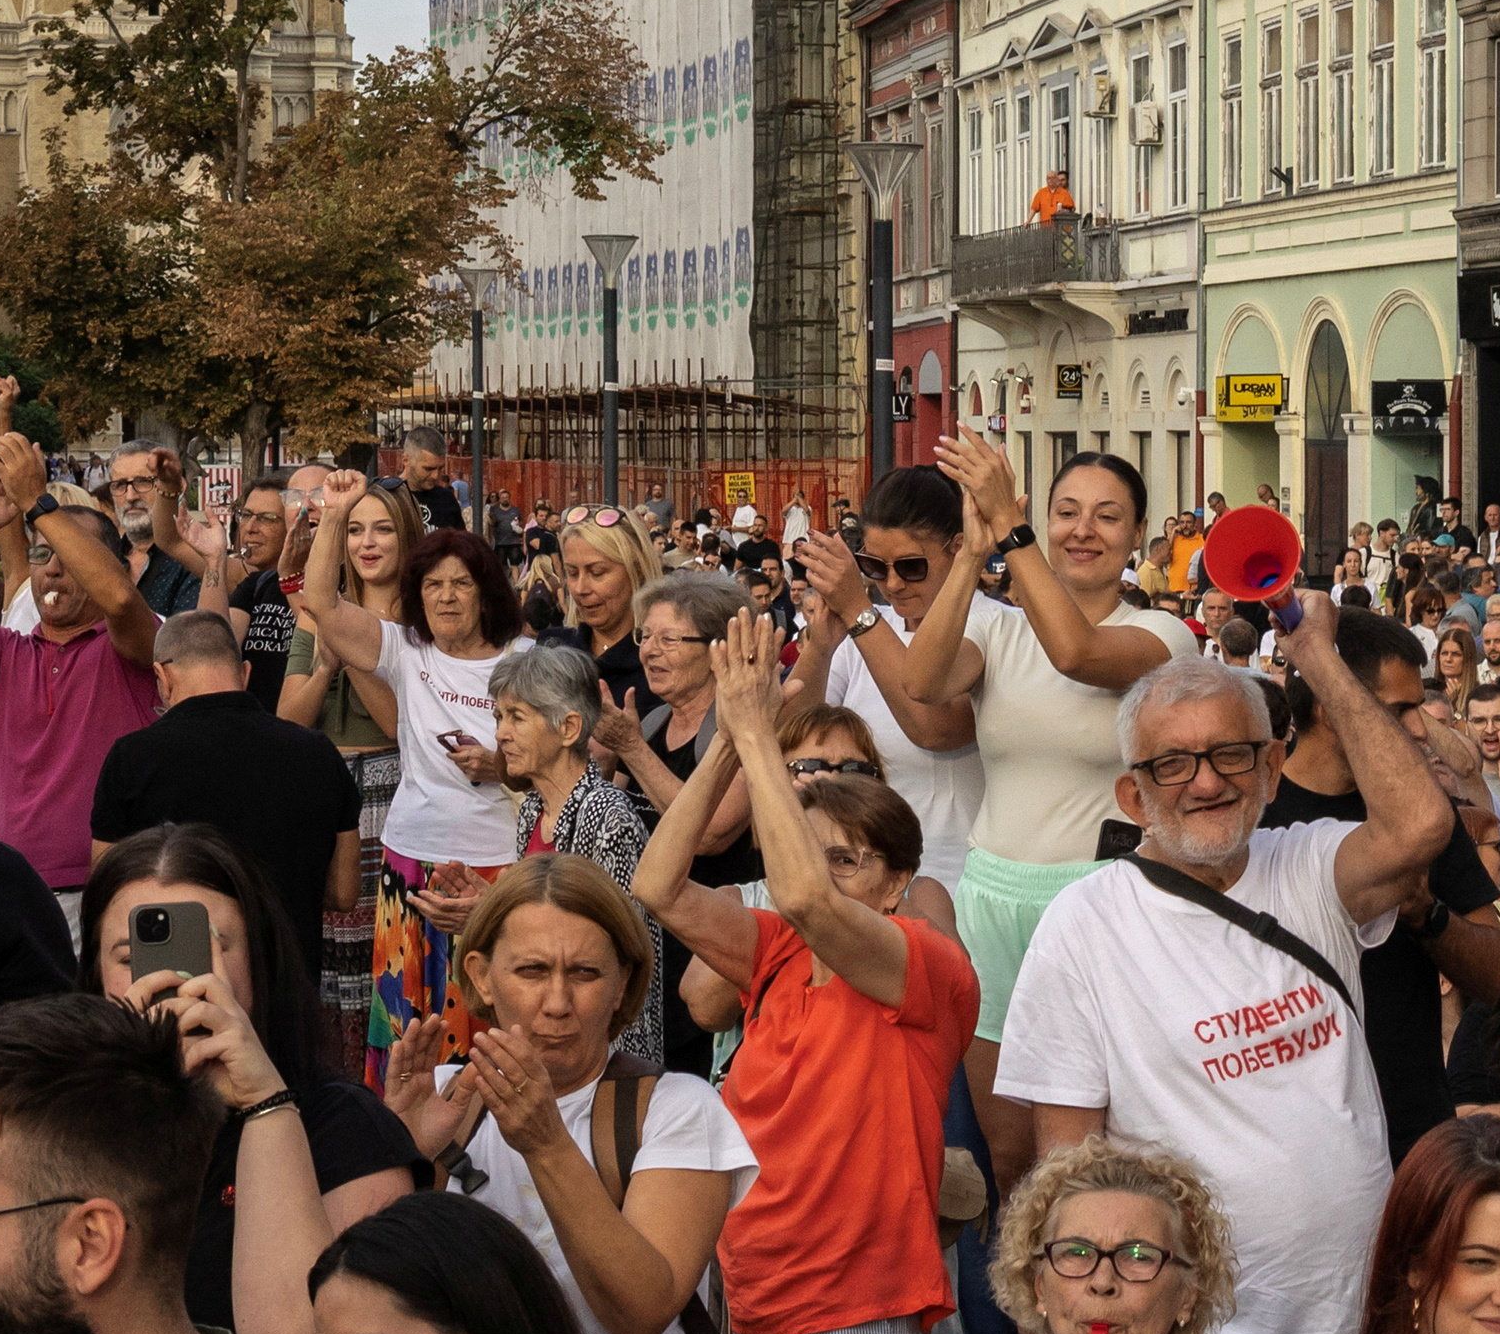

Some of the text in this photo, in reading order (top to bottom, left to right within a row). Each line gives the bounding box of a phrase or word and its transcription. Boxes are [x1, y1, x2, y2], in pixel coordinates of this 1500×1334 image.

[892, 395, 909, 415] LY
[1233, 382, 1276, 394] URBAN
[1192, 982, 1326, 1046] СТУДЕНТИ
[1201, 1014, 1344, 1085] ПОБЕЂУЈУ!
